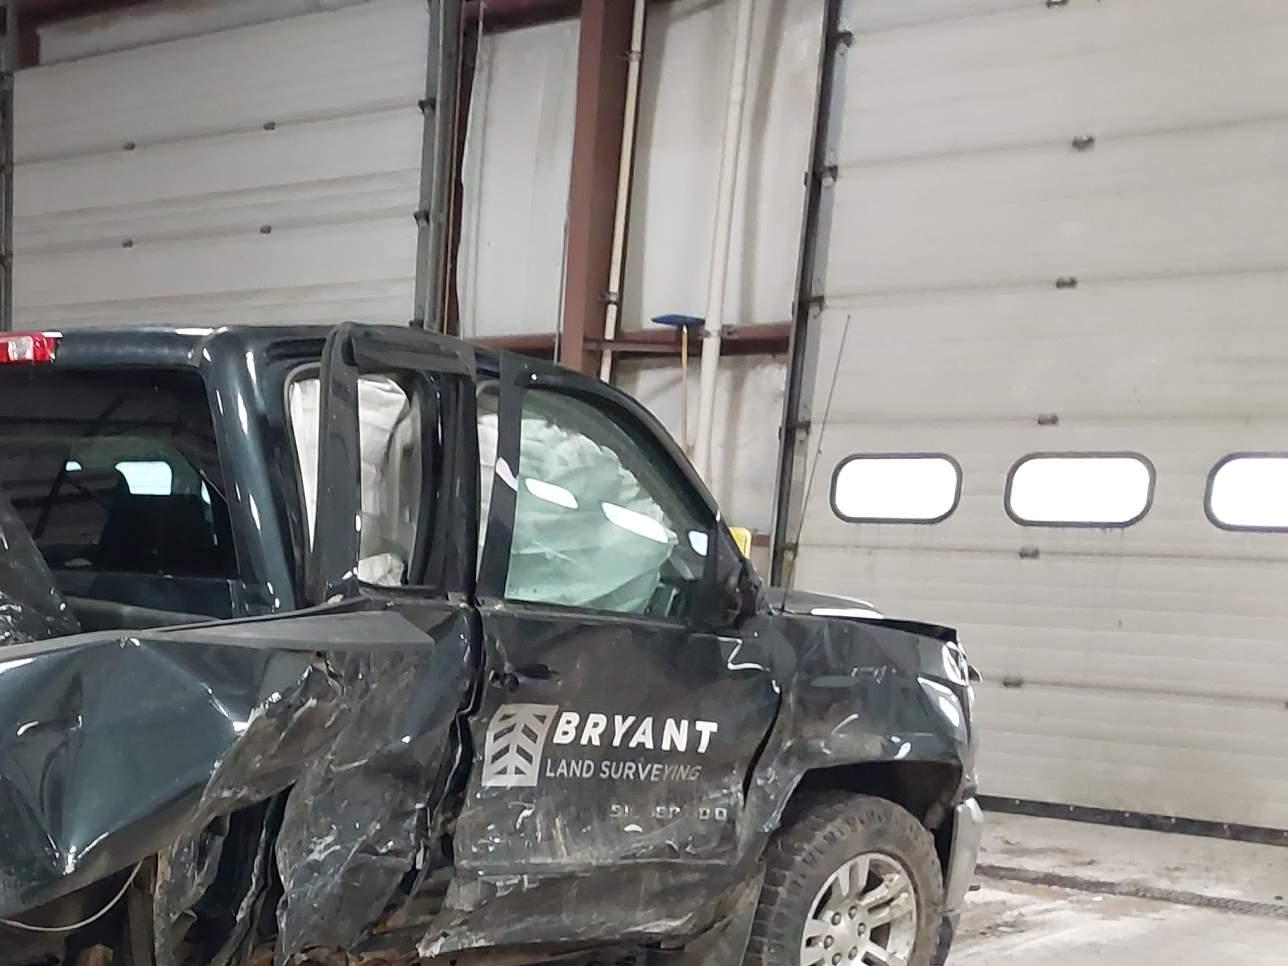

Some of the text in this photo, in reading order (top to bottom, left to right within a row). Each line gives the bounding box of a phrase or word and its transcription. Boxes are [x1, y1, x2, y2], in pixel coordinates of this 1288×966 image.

[553, 711, 718, 753] BRYANT
[546, 758, 702, 782] LAND SURVEYING
